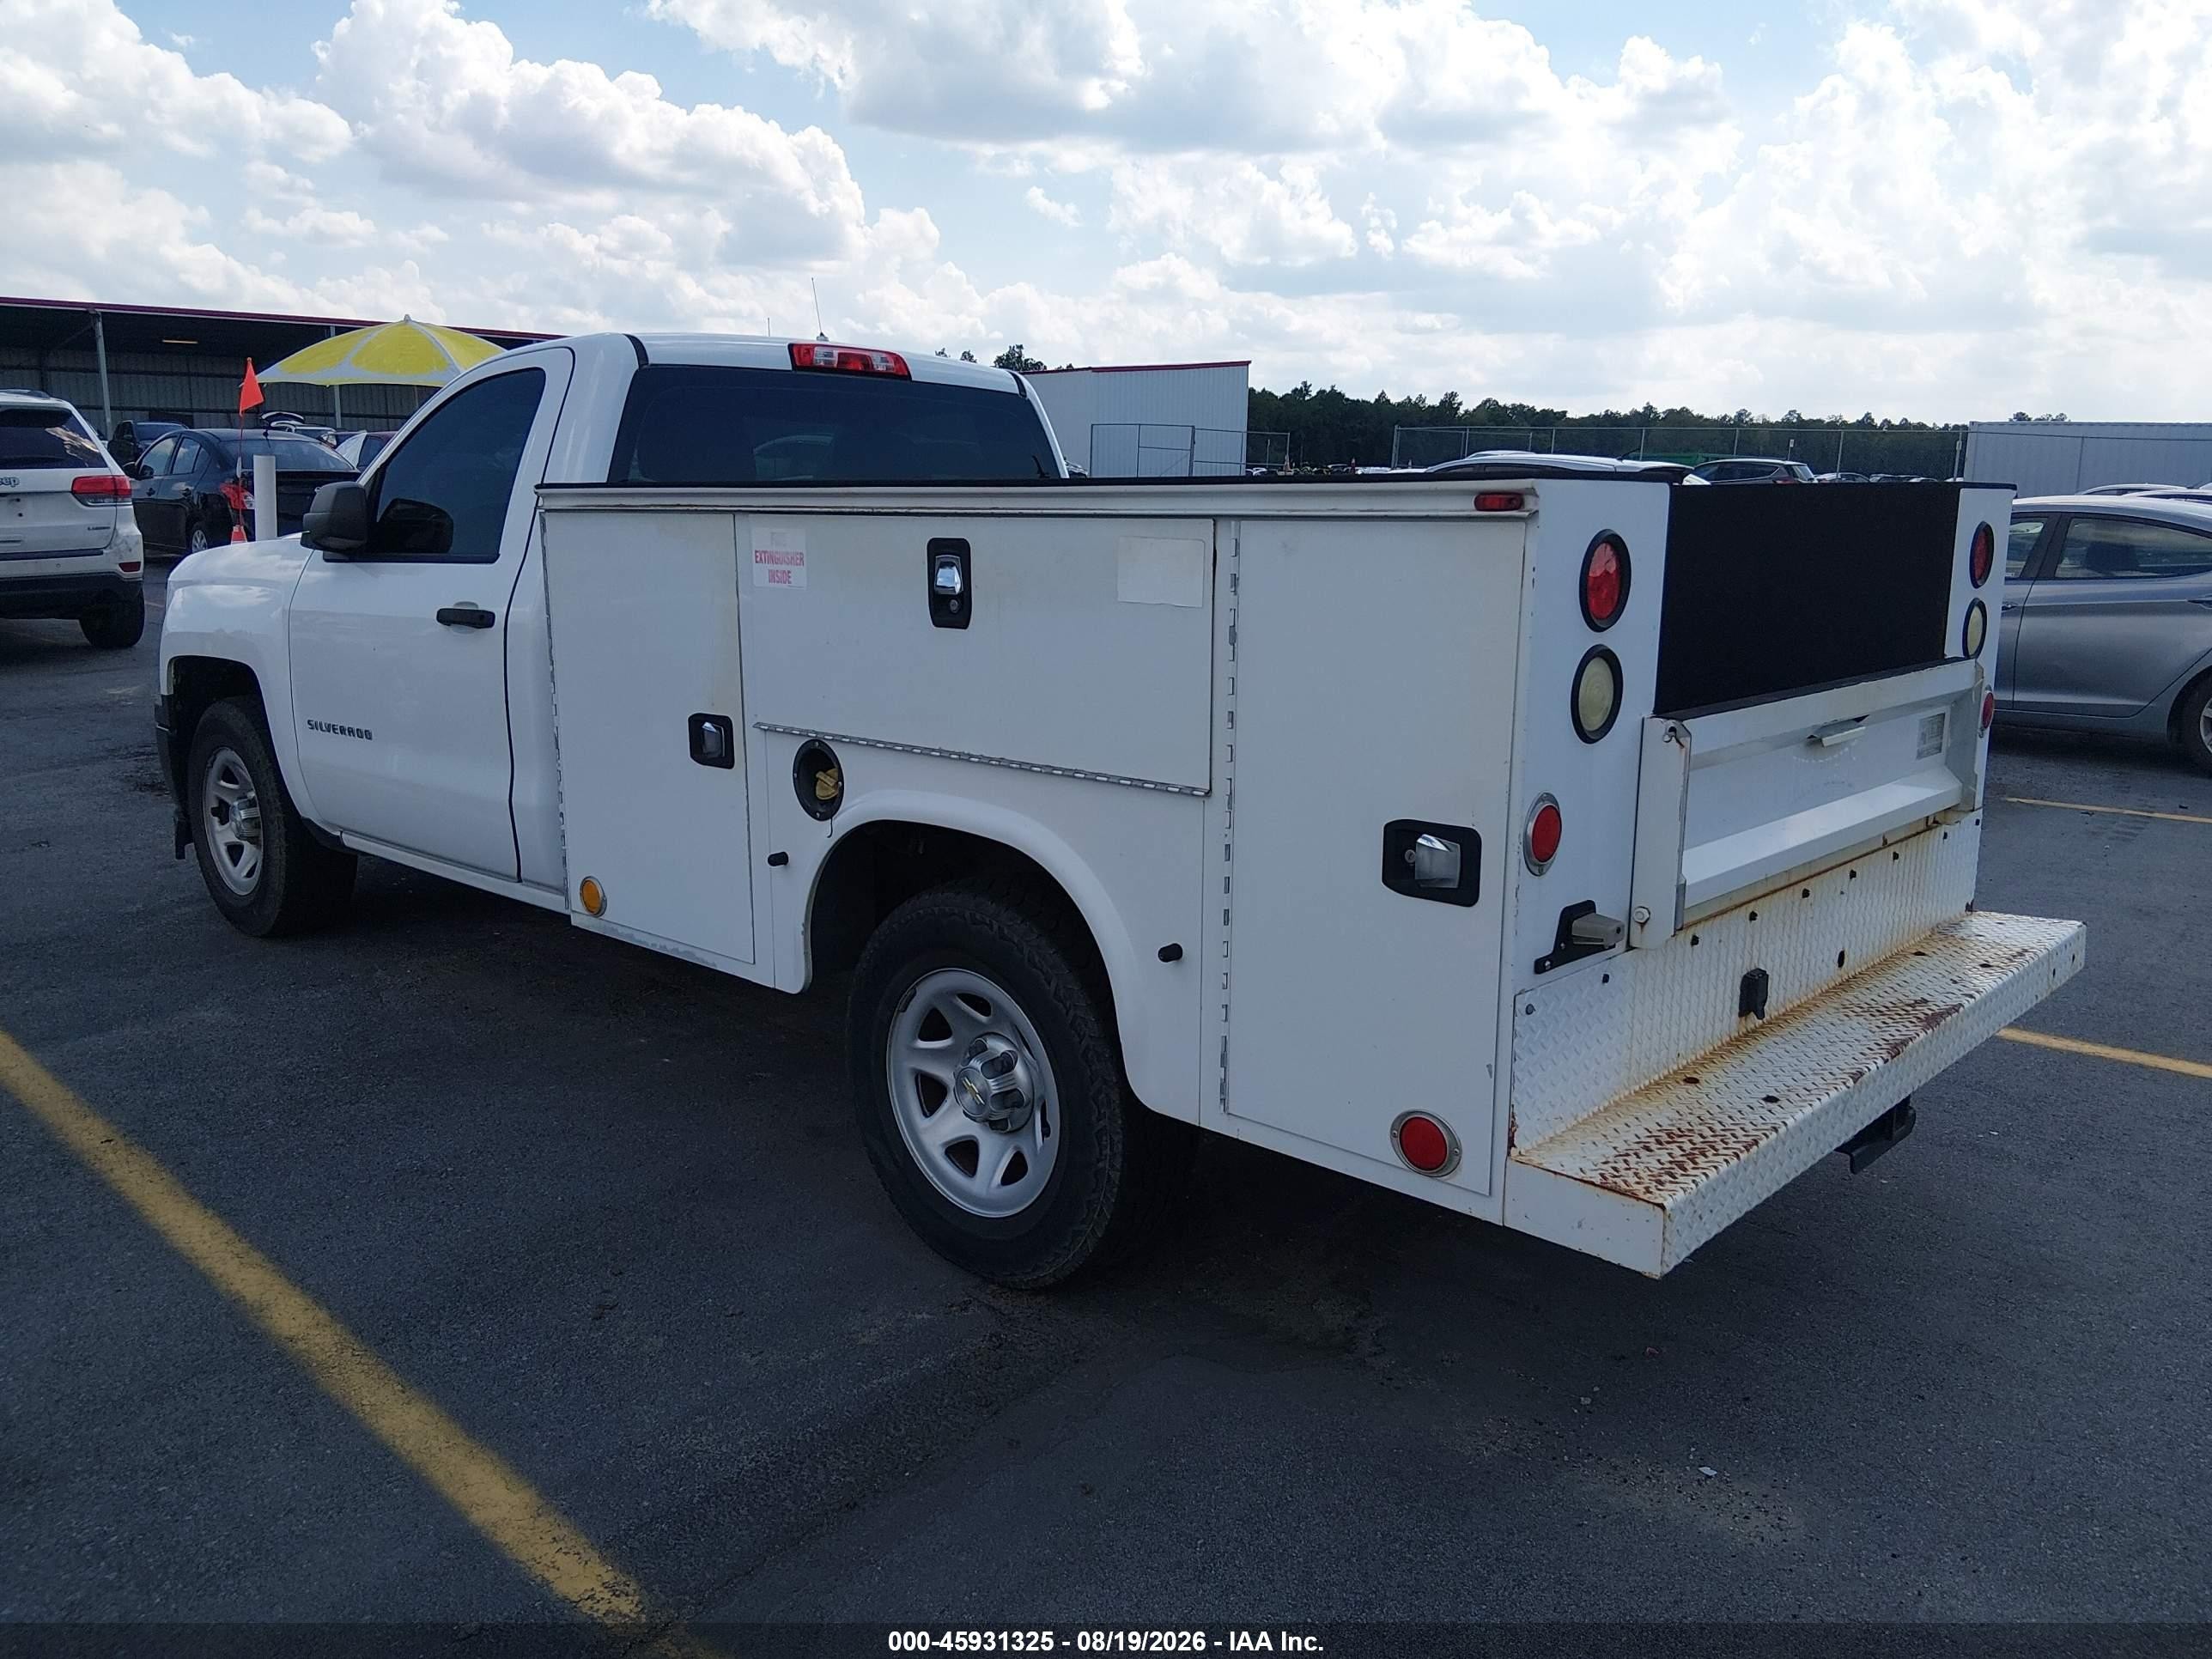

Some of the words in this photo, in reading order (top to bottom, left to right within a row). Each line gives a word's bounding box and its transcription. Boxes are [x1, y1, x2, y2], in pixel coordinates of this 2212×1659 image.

[754, 549, 805, 567] EXTINGUISHER
[768, 568, 792, 585] INSIDE
[307, 719, 373, 741] SILVERADO
